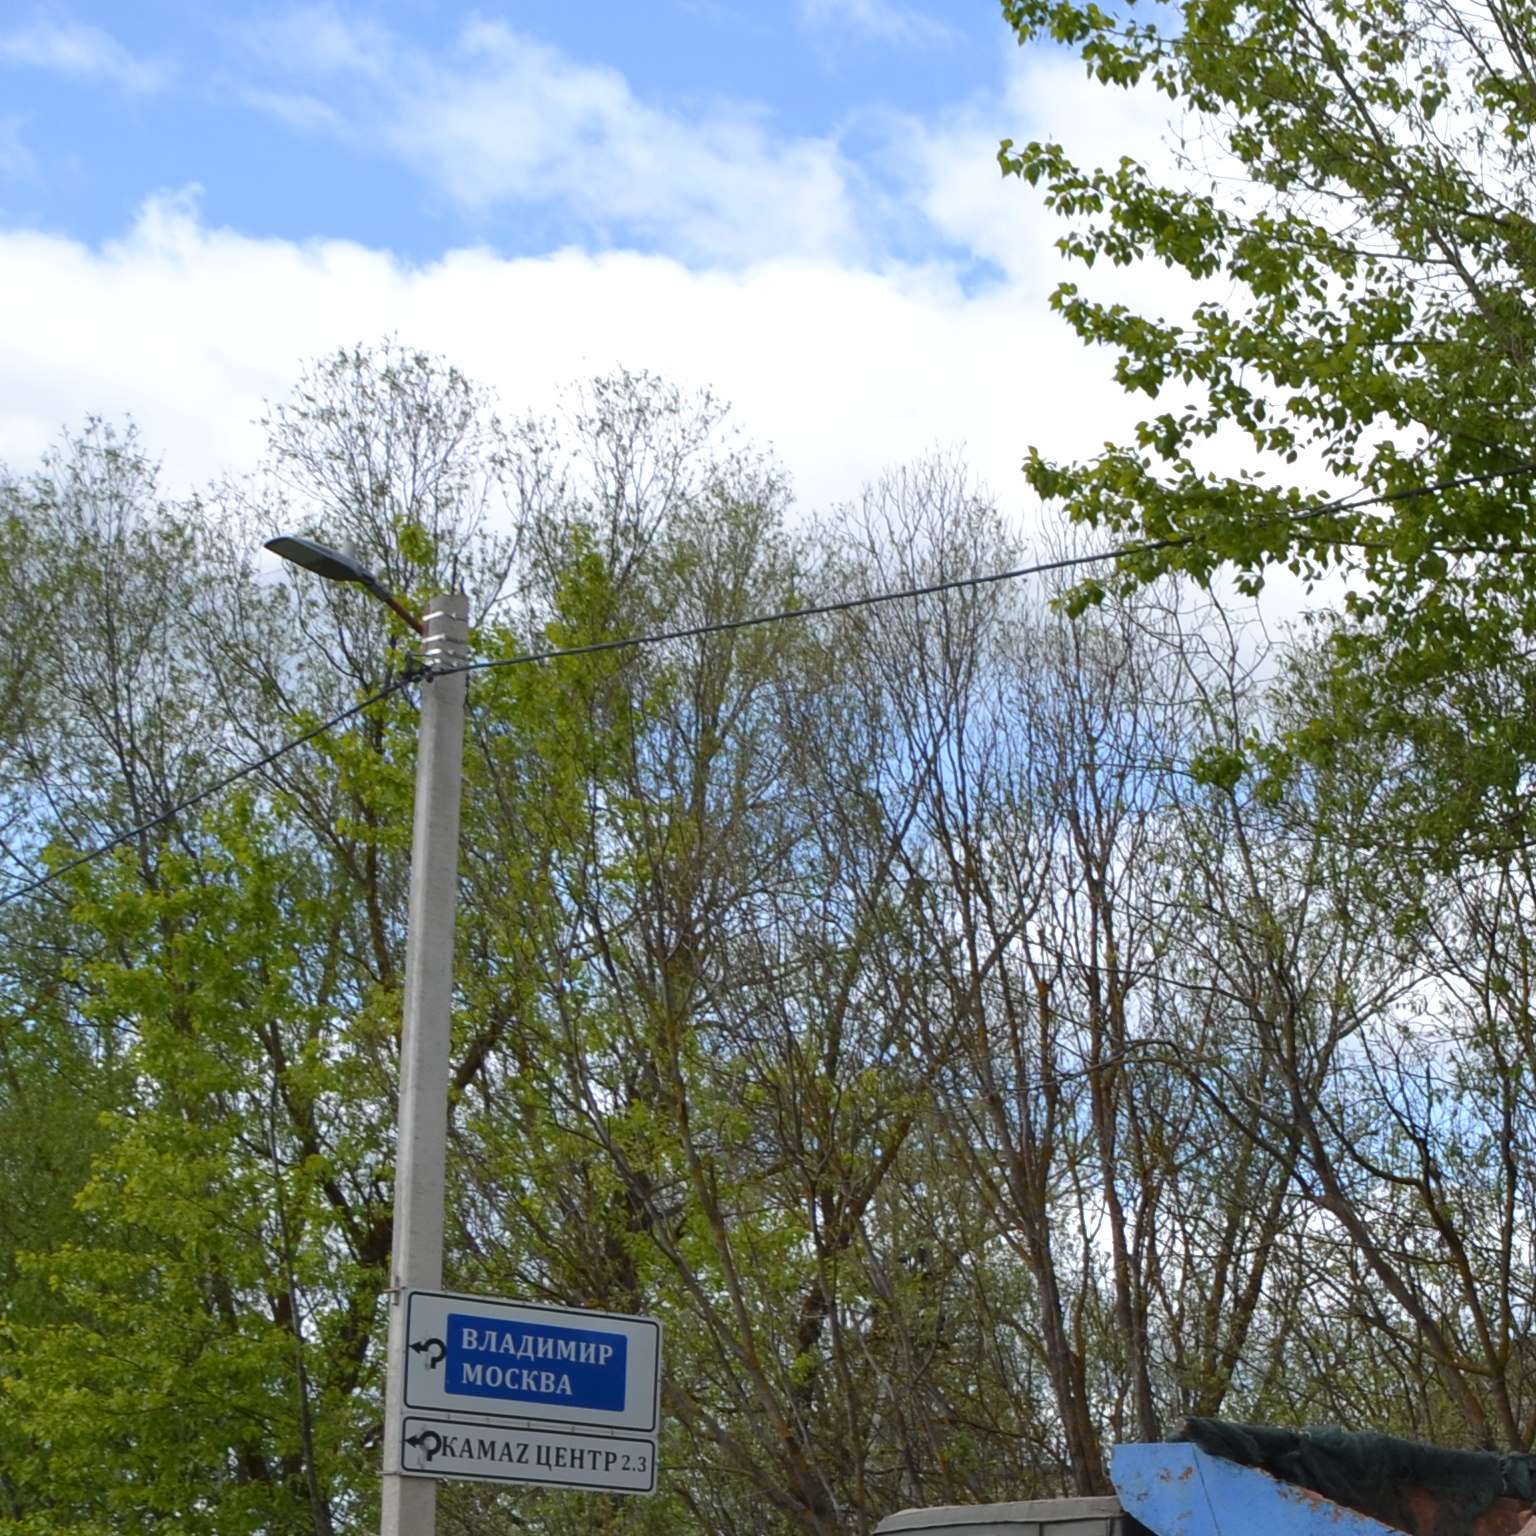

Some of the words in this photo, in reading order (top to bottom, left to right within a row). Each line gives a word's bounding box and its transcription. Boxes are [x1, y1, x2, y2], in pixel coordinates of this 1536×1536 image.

[461, 1328, 613, 1366] ВЛАДИМИР
[461, 1363, 573, 1396] МОСКВА
[536, 1444, 618, 1472] ЦЕНТР
[621, 1454, 648, 1473] 2.3
